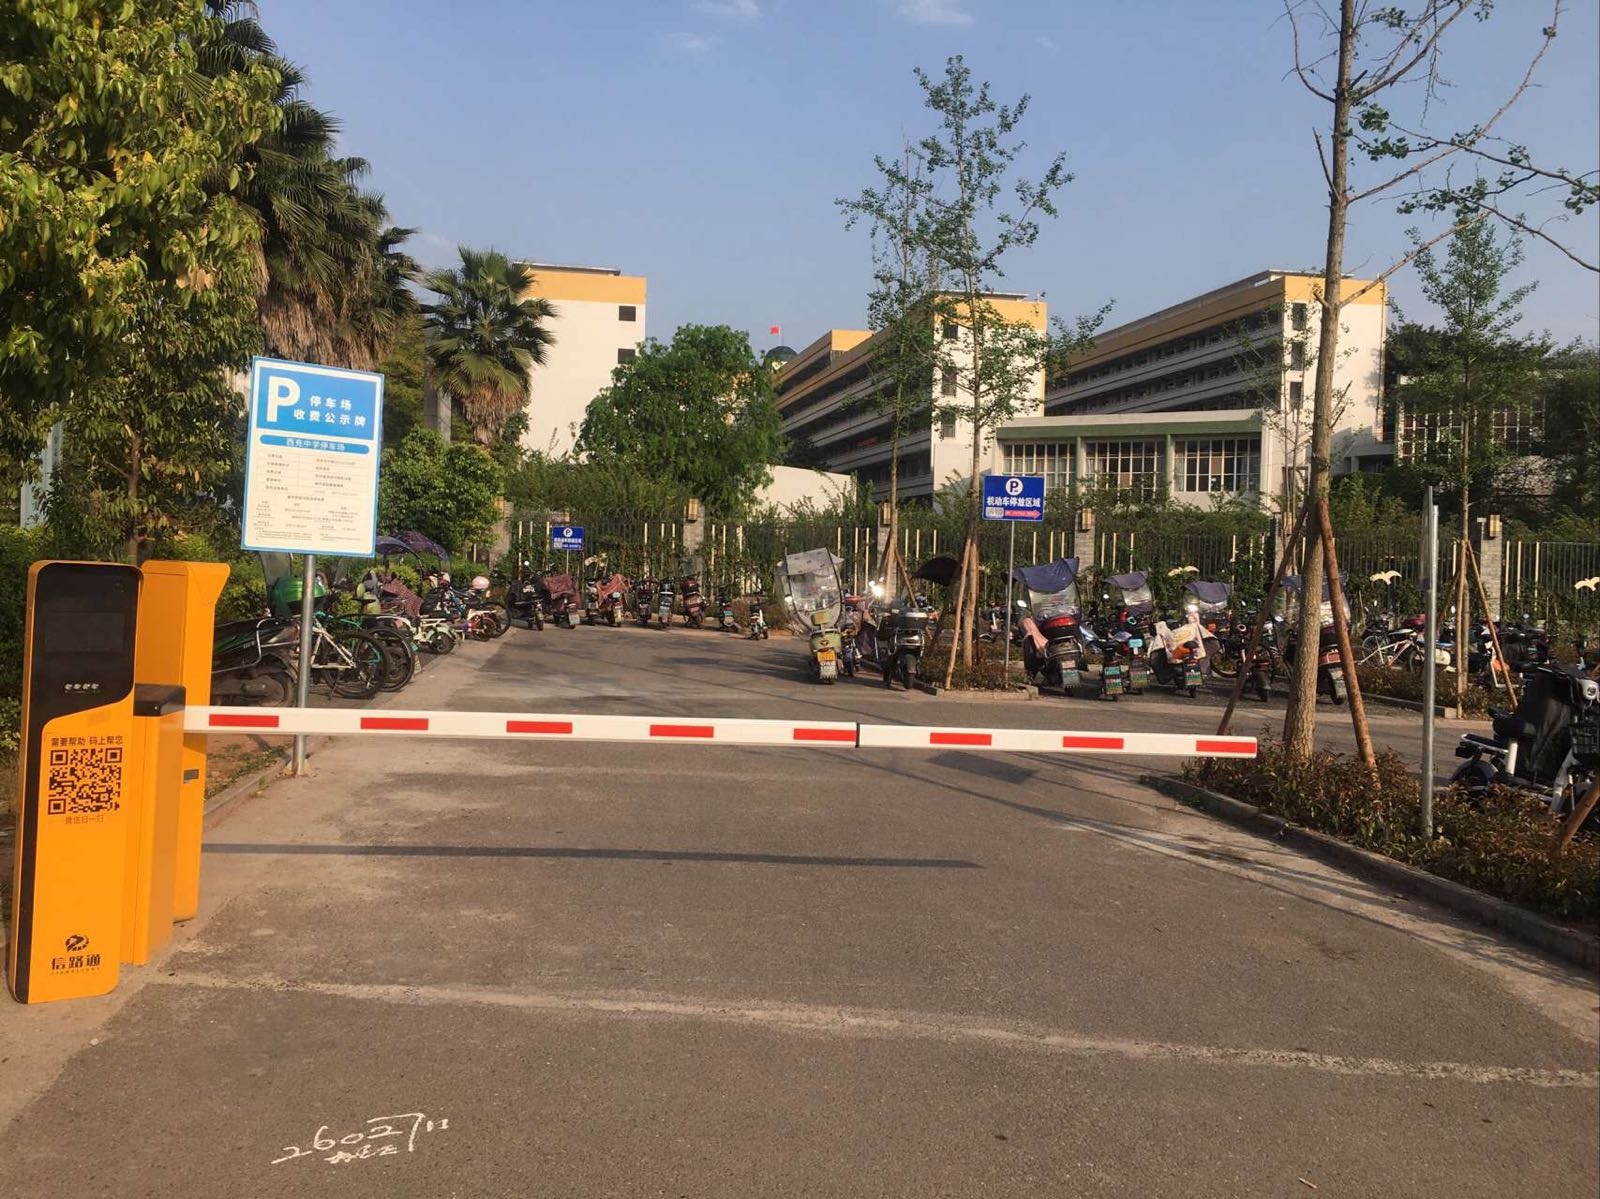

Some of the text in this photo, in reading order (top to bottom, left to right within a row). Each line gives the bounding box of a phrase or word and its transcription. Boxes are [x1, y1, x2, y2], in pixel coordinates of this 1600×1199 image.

[267, 376, 300, 422] P
[310, 396, 352, 411] 停车场
[294, 408, 366, 427] 收费公示牌
[987, 496, 1041, 508] 机动车停放区域
[51, 953, 100, 970] 信路通
